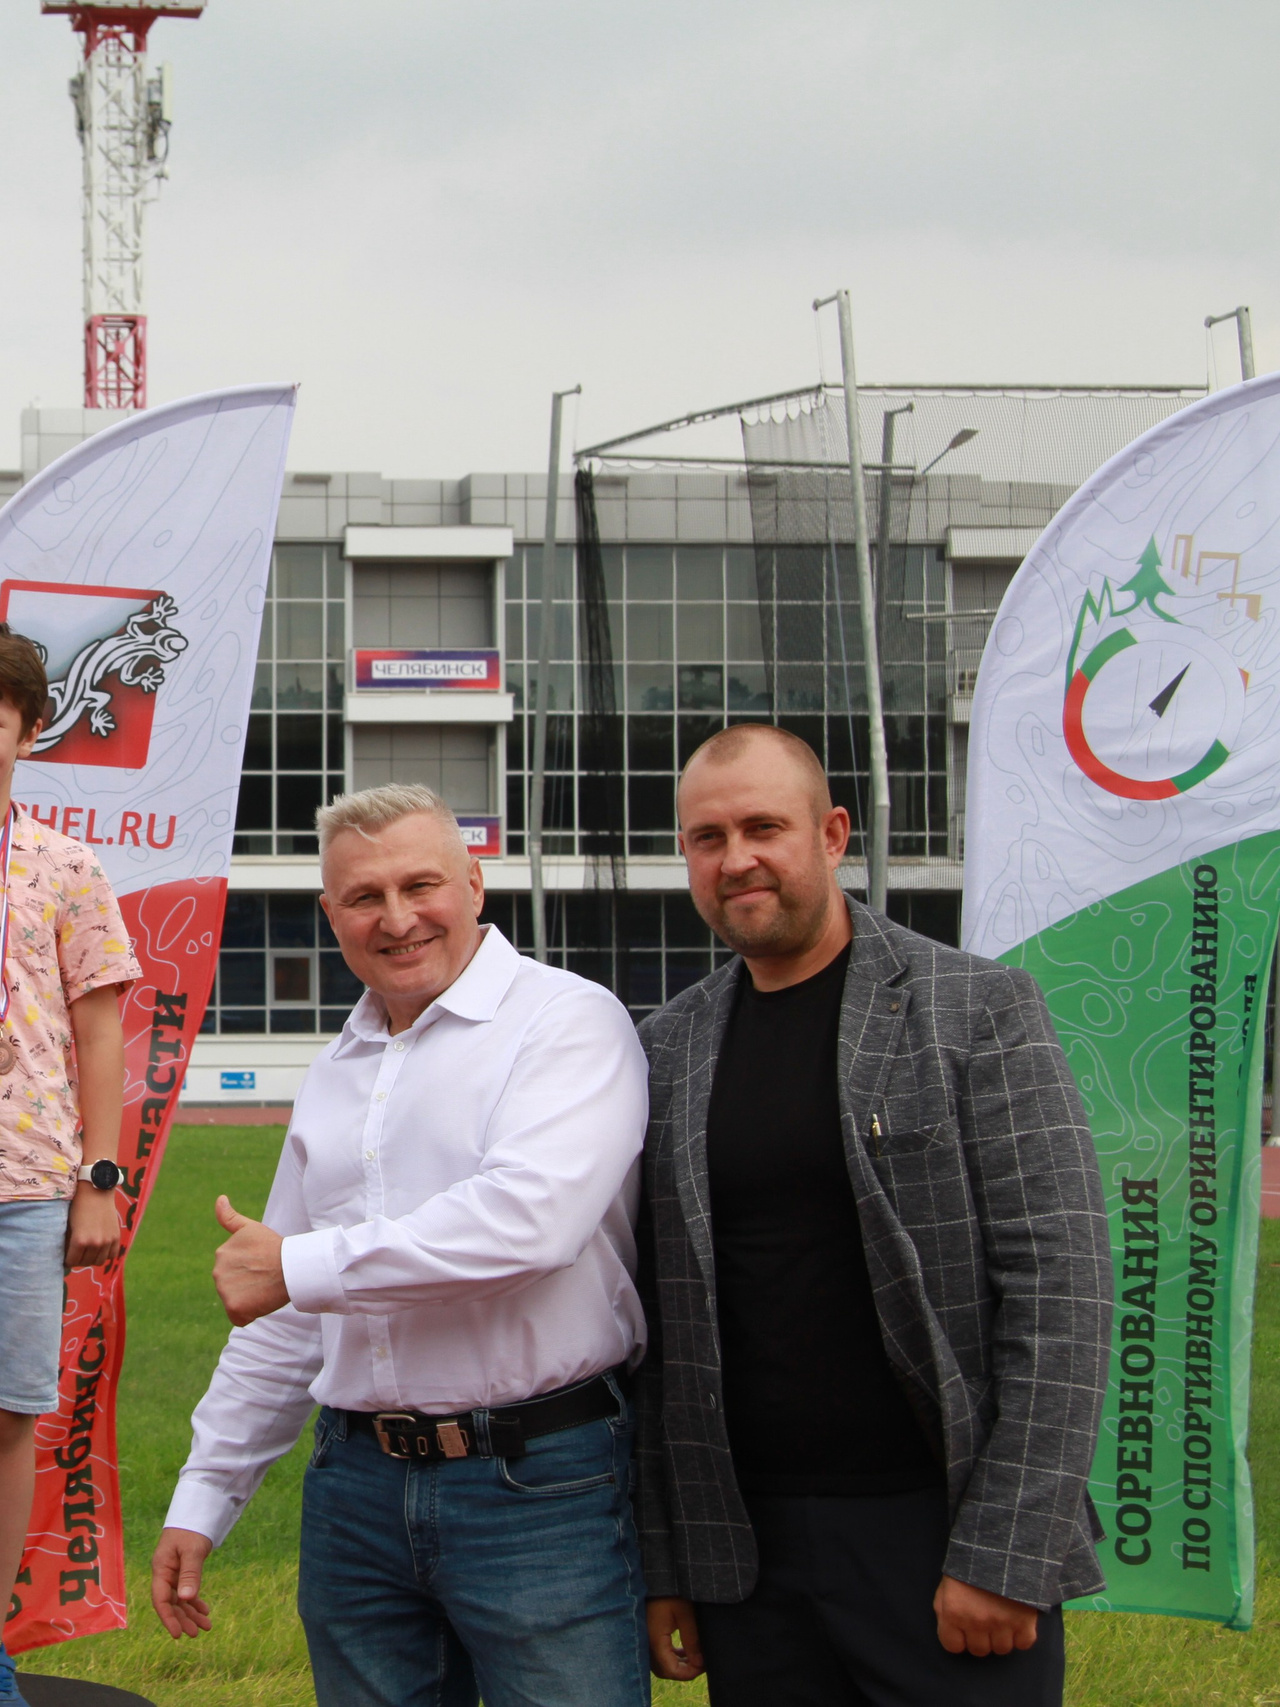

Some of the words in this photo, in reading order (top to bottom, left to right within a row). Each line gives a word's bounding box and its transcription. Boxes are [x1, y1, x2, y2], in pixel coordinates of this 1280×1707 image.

[374, 663, 484, 676] ЧЕЛЯБИНСК
[1188, 864, 1219, 1226] ОРИЕНТИРОВАНИЮ
[1114, 1177, 1159, 1566] СОРЕВНОВАНИЯ
[1182, 1232, 1218, 1511] СПОРТИВНОМУ
[1181, 1517, 1212, 1572] ПО
